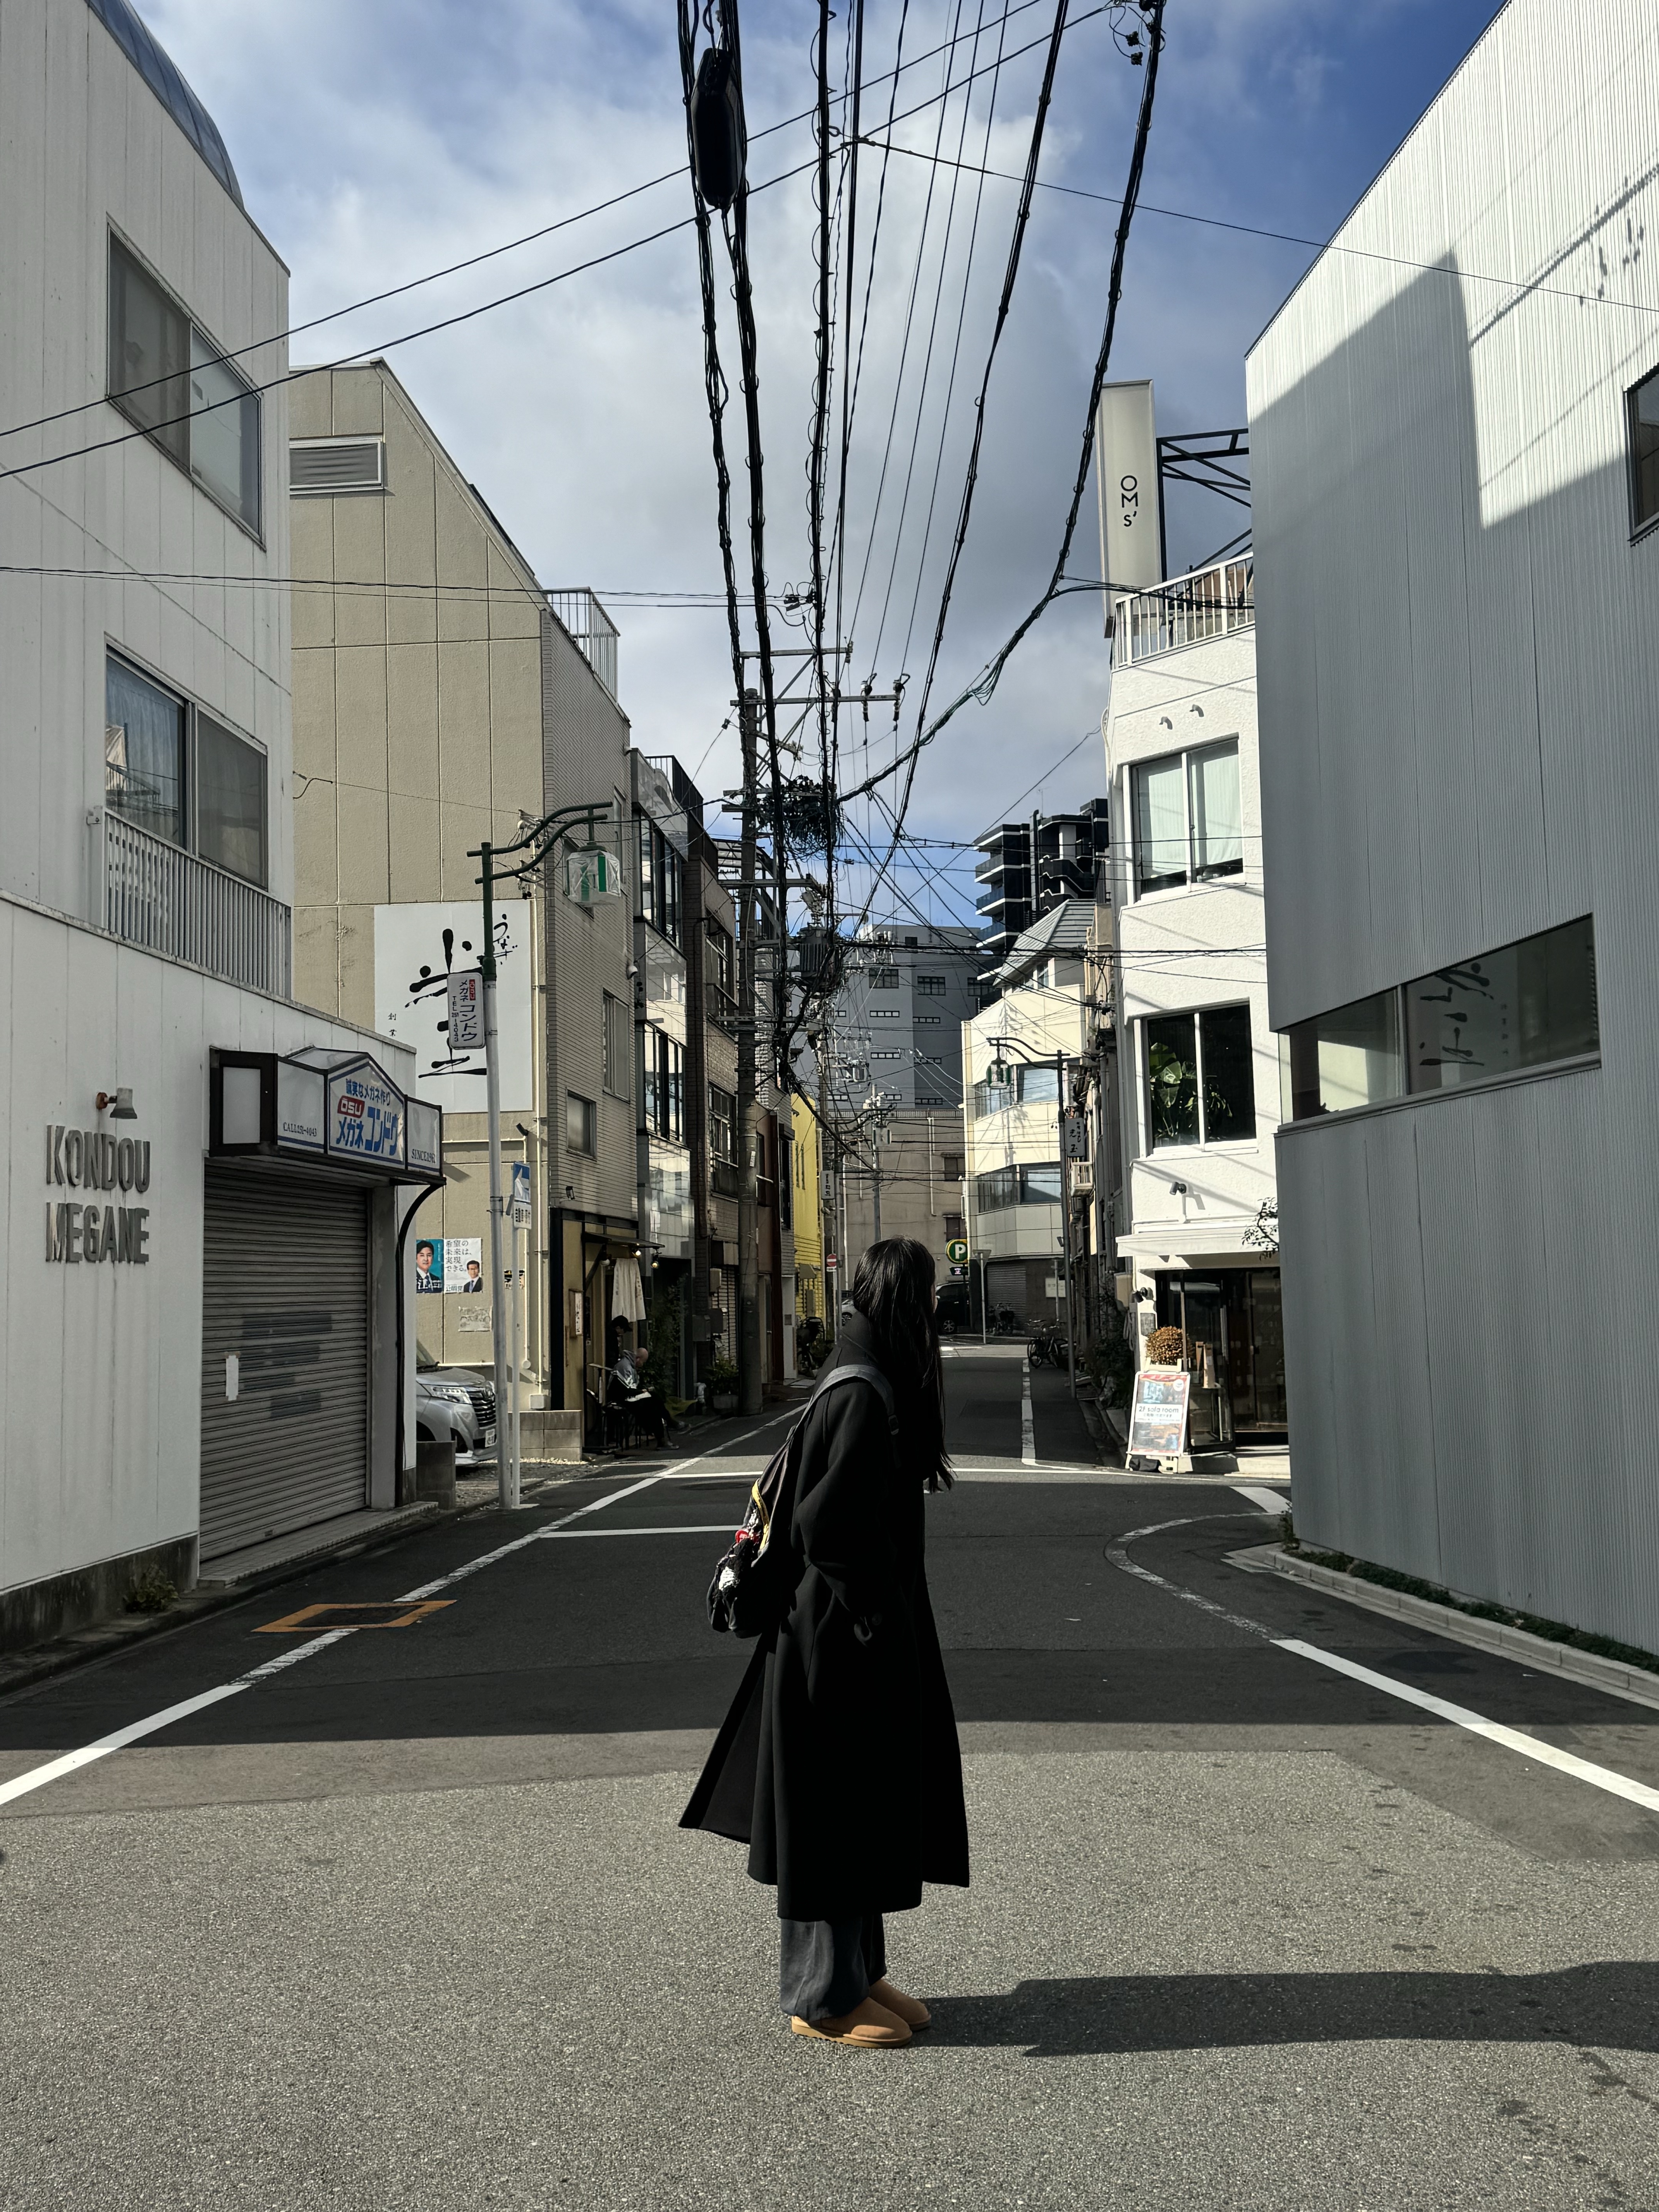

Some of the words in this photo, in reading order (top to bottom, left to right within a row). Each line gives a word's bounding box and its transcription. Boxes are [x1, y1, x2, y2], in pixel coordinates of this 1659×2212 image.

[459, 979, 469, 1002] メガネ
[460, 1005, 477, 1041] コンドウ
[346, 1078, 391, 1106] 誠実なメガネ作り
[336, 1116, 364, 1149] メガネ
[364, 1106, 398, 1156] コンドウ
[46, 1125, 150, 1193] KONDOU
[46, 1202, 149, 1264] MEGANE
[446, 1256, 461, 1264] 実現
[955, 1244, 966, 1259] P
